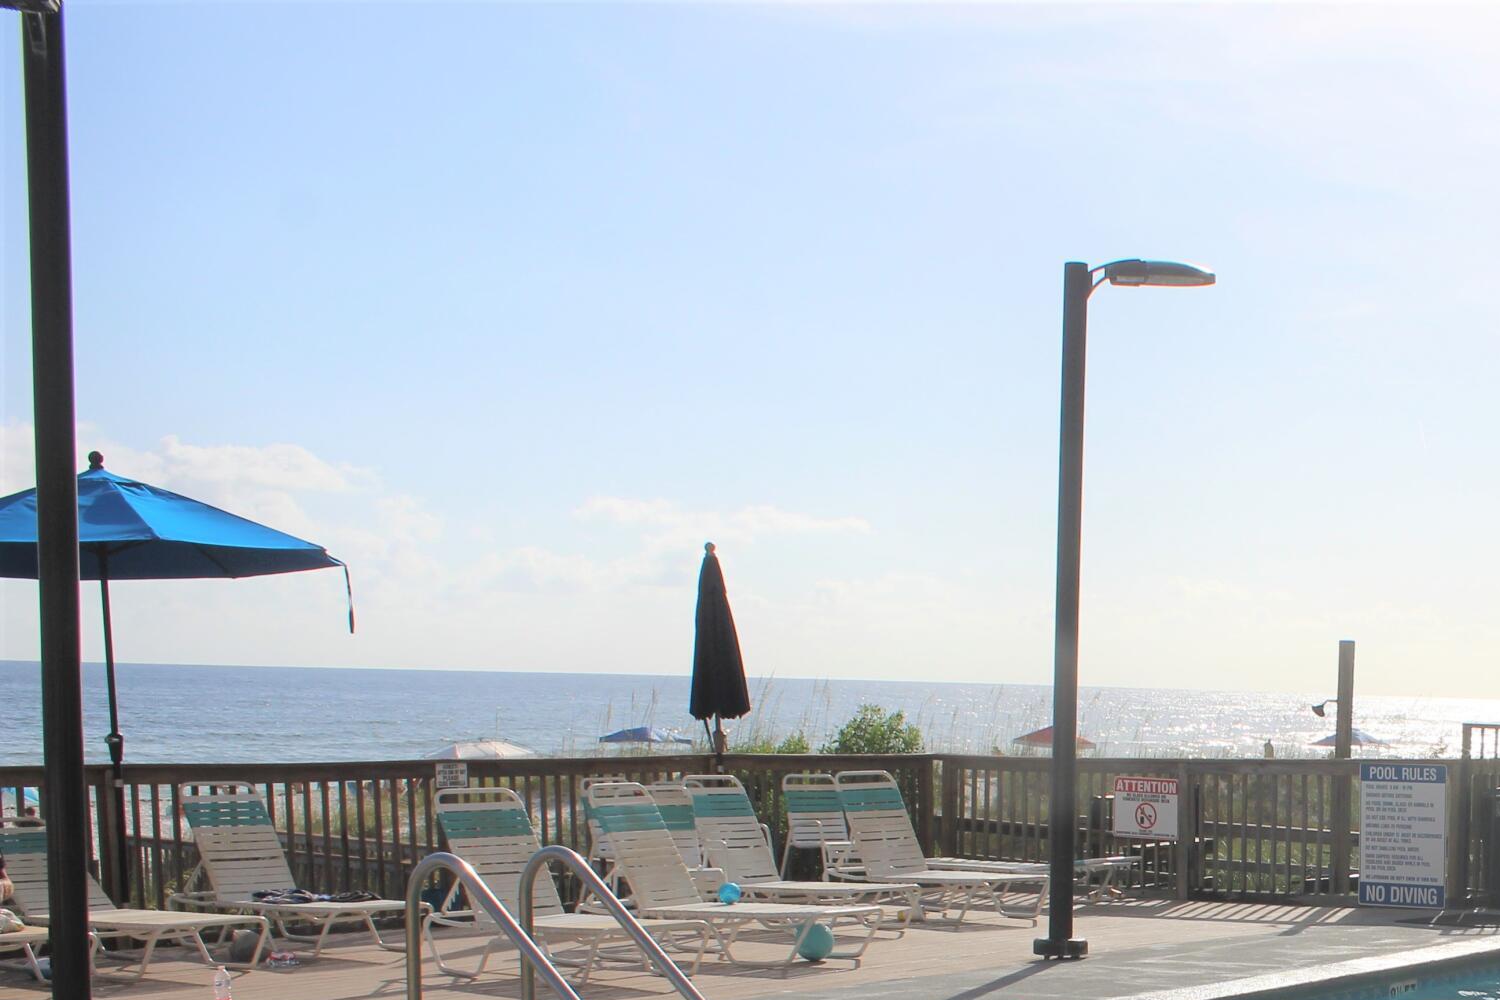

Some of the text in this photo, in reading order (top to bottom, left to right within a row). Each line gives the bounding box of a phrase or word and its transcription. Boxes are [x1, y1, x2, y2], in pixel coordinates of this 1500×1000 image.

[1369, 766, 1437, 781] POOL RULES
[1116, 780, 1177, 794] ATTENTION
[1366, 884, 1438, 905] NO DIVING
